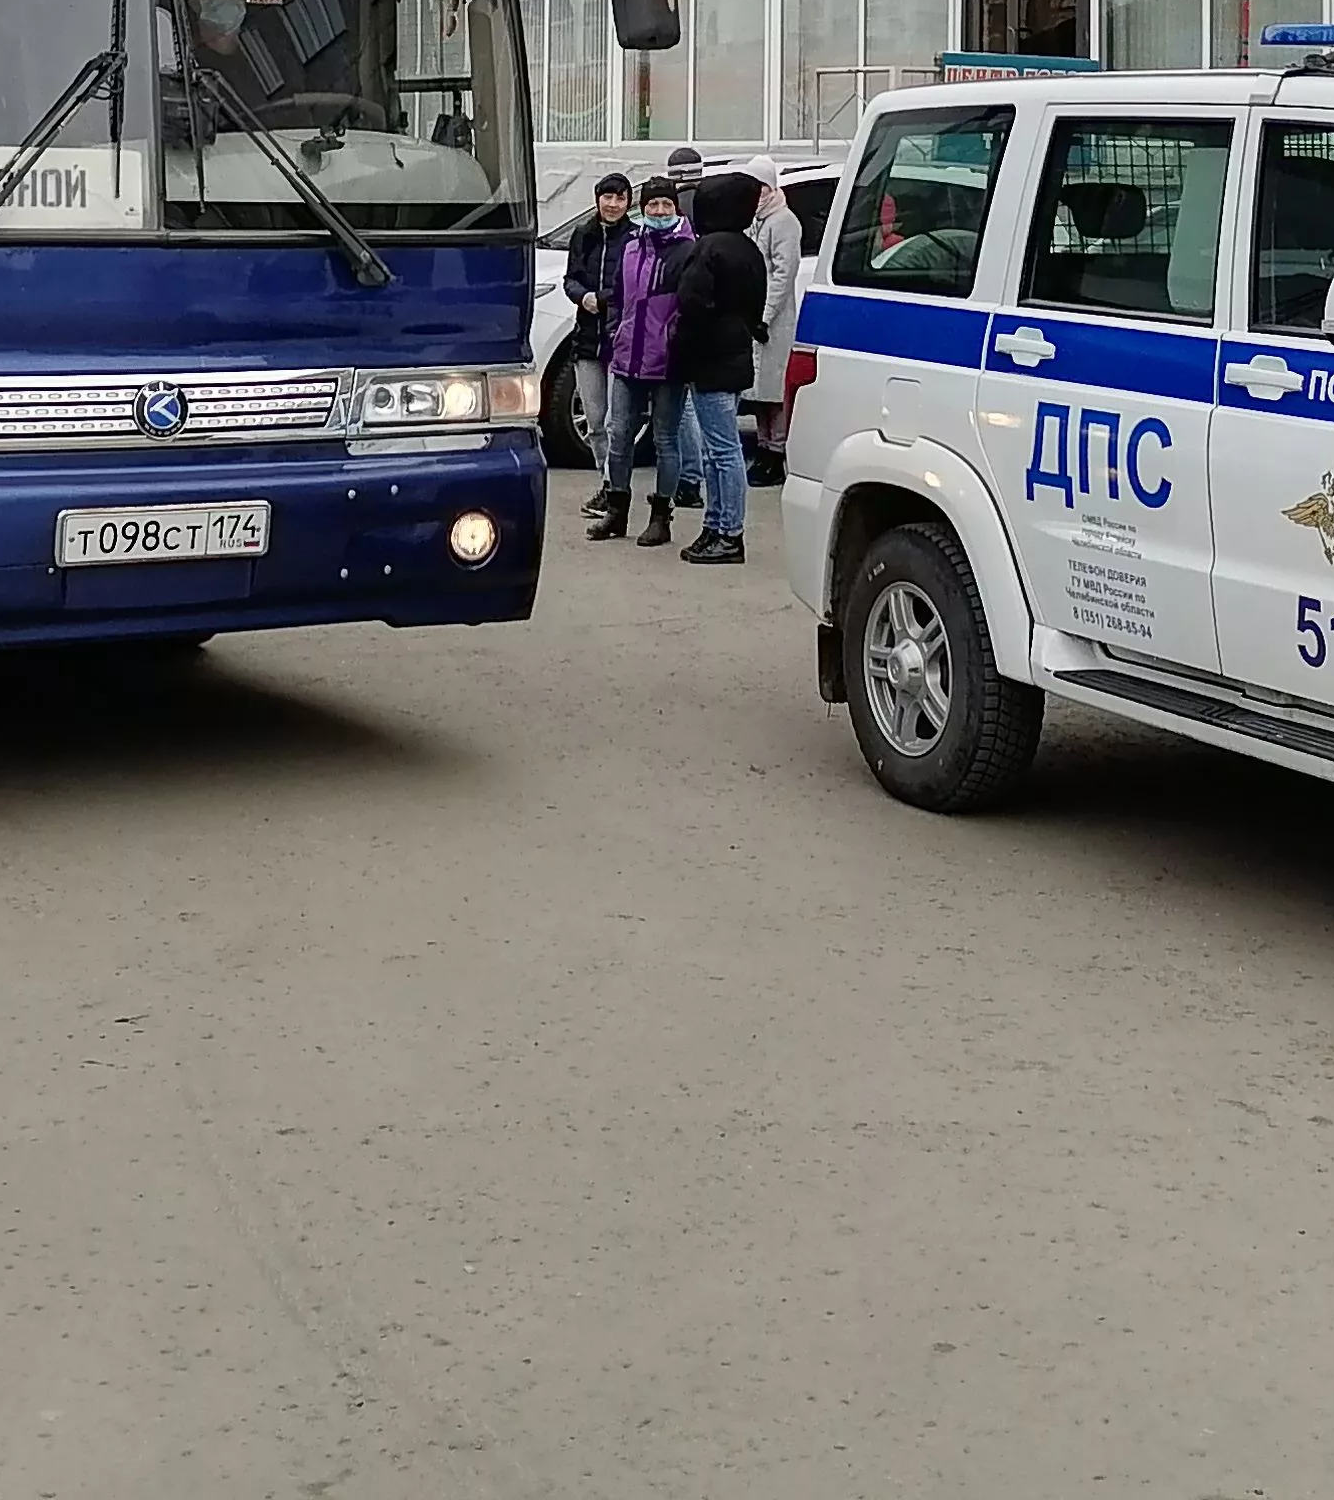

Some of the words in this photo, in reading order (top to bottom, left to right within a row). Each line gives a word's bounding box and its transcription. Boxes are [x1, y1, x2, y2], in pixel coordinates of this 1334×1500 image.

[1025, 400, 1173, 510] ДПС
[212, 513, 257, 541] 174
[1068, 560, 1106, 578] ТЕЛЕФОН
[1107, 568, 1147, 588] ДОВЕРИЯ
[1104, 584, 1133, 601] России
[1073, 606, 1079, 620] 8
[1081, 608, 1104, 630] (351)
